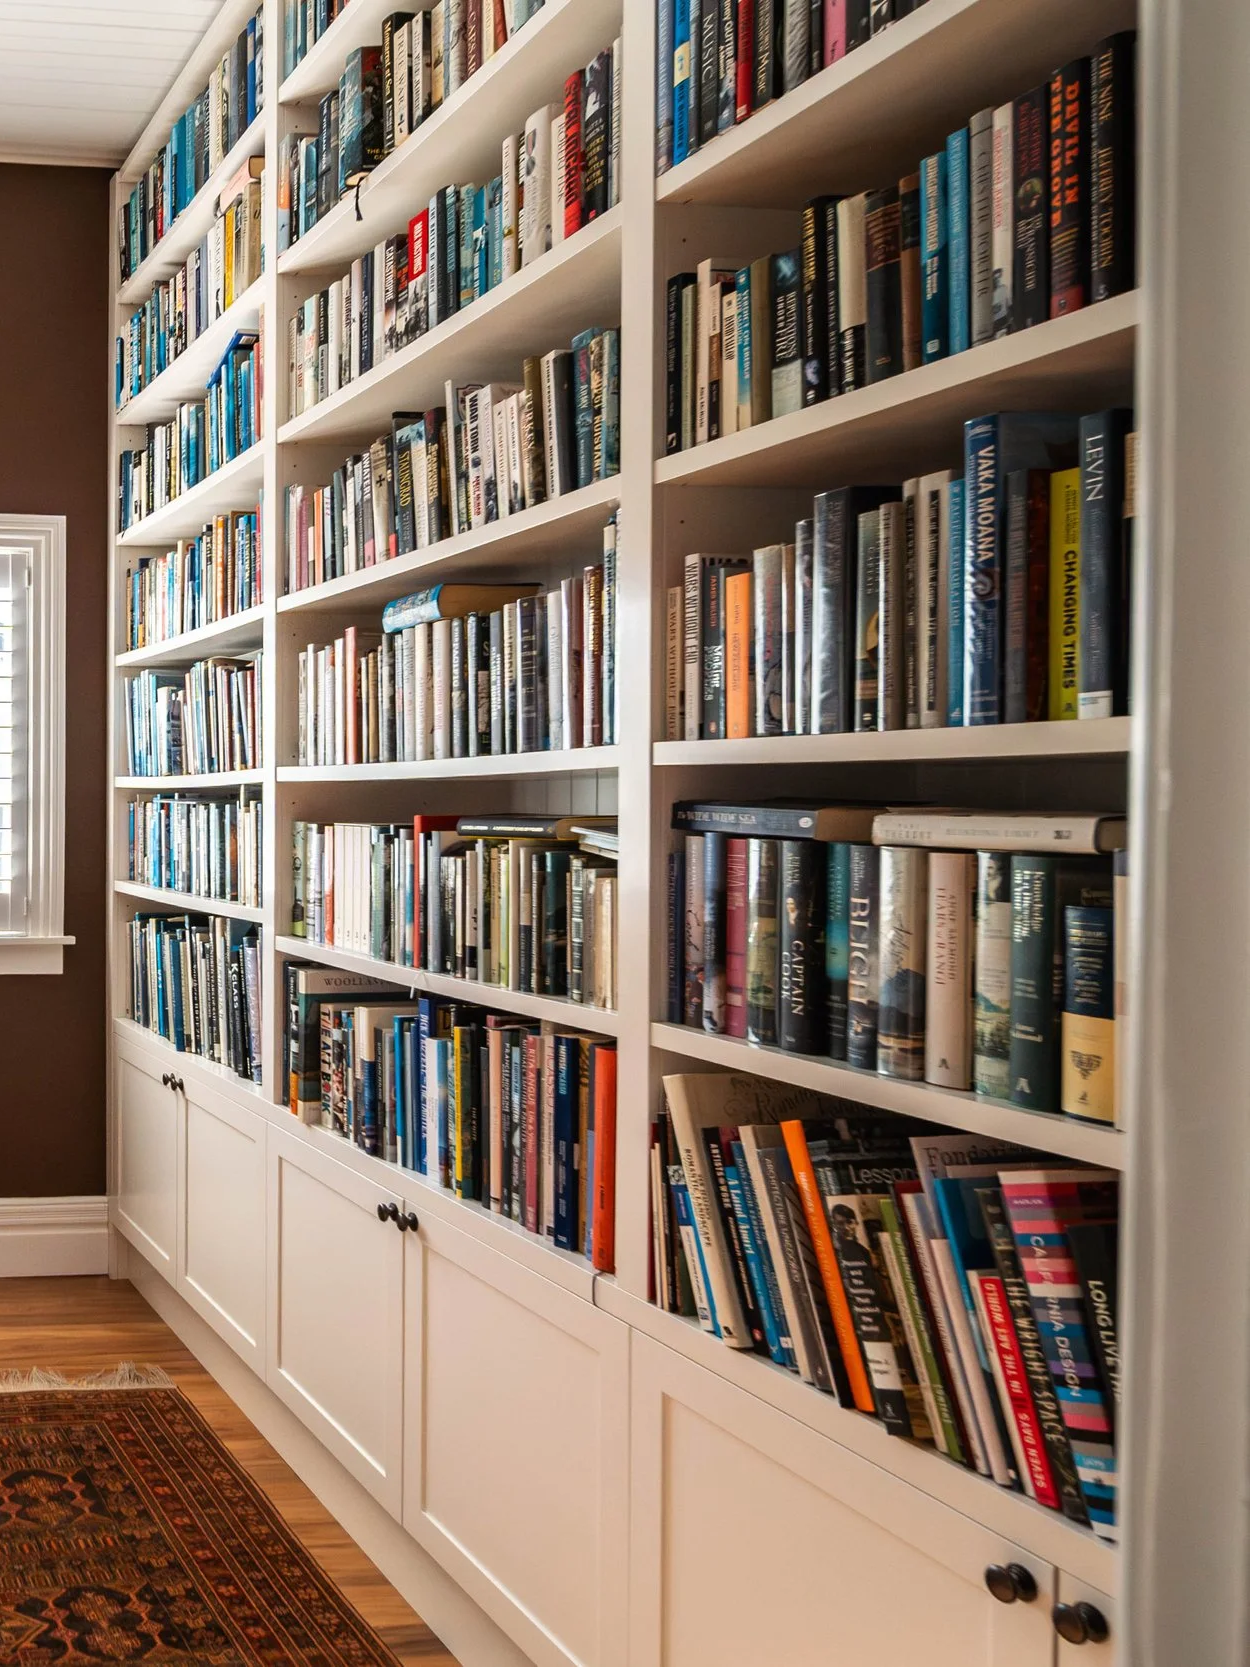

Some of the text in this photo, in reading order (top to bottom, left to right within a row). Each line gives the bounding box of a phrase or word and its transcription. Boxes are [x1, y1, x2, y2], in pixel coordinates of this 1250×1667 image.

[383, 18, 394, 71] Monsarrat
[396, 28, 408, 104] TRUE WAR
[466, 11, 478, 75] CAESAR
[702, 12, 718, 84] MUSIC
[1098, 48, 1114, 74] THE
[385, 79, 393, 98] Sea
[1098, 84, 1113, 125] NINE
[564, 78, 582, 208] STALINGRAD
[1050, 75, 1063, 230] THE GROVE
[1065, 80, 1080, 206] DEVIL IN
[557, 175, 565, 204] FISK
[412, 220, 424, 276] MAX HASTINGS
[976, 151, 992, 299] CHESTER PORTER
[1099, 208, 1114, 270] TOOBIN
[384, 245, 396, 304] CATASTROPHE
[469, 393, 480, 455] WAR TORN
[579, 384, 588, 409] ARMY
[362, 452, 371, 502] AWATERE
[399, 450, 412, 507] STALINGRAD
[1085, 433, 1104, 502] LEVIN
[976, 444, 995, 563] VAKA MOANA
[685, 562, 699, 665] WARS WITHOUT END
[1062, 549, 1077, 637] CHANGING
[668, 611, 678, 731] WARS WITHOUT END
[711, 645, 723, 689] Making
[1062, 640, 1077, 689] TIMES
[231, 963, 239, 973] K
[780, 952, 791, 1001] COOK
[791, 939, 805, 1016] CAPTAIN
[850, 896, 869, 1006] BLIGH
[420, 1013, 429, 1031] DICK
[321, 1008, 333, 1116] THE ART BOOK
[527, 1048, 535, 1072] RITA
[527, 1072, 535, 1105] ANGUS
[710, 1143, 732, 1209] ARTISTS WORK
[731, 1188, 748, 1218] Land
[764, 1157, 787, 1225] ARCHITECTURE
[694, 1195, 712, 1247] LANDSCAPE
[737, 1221, 756, 1255] Apart
[1087, 1279, 1113, 1328] LONG
[1003, 1277, 1066, 1444] THE WRIGHT SPACE
[1056, 1336, 1081, 1397] DESIGN
[1098, 1330, 1120, 1367] LIVE
[983, 1283, 1047, 1488] SEVEN DAYS IN THE ART WORLD
